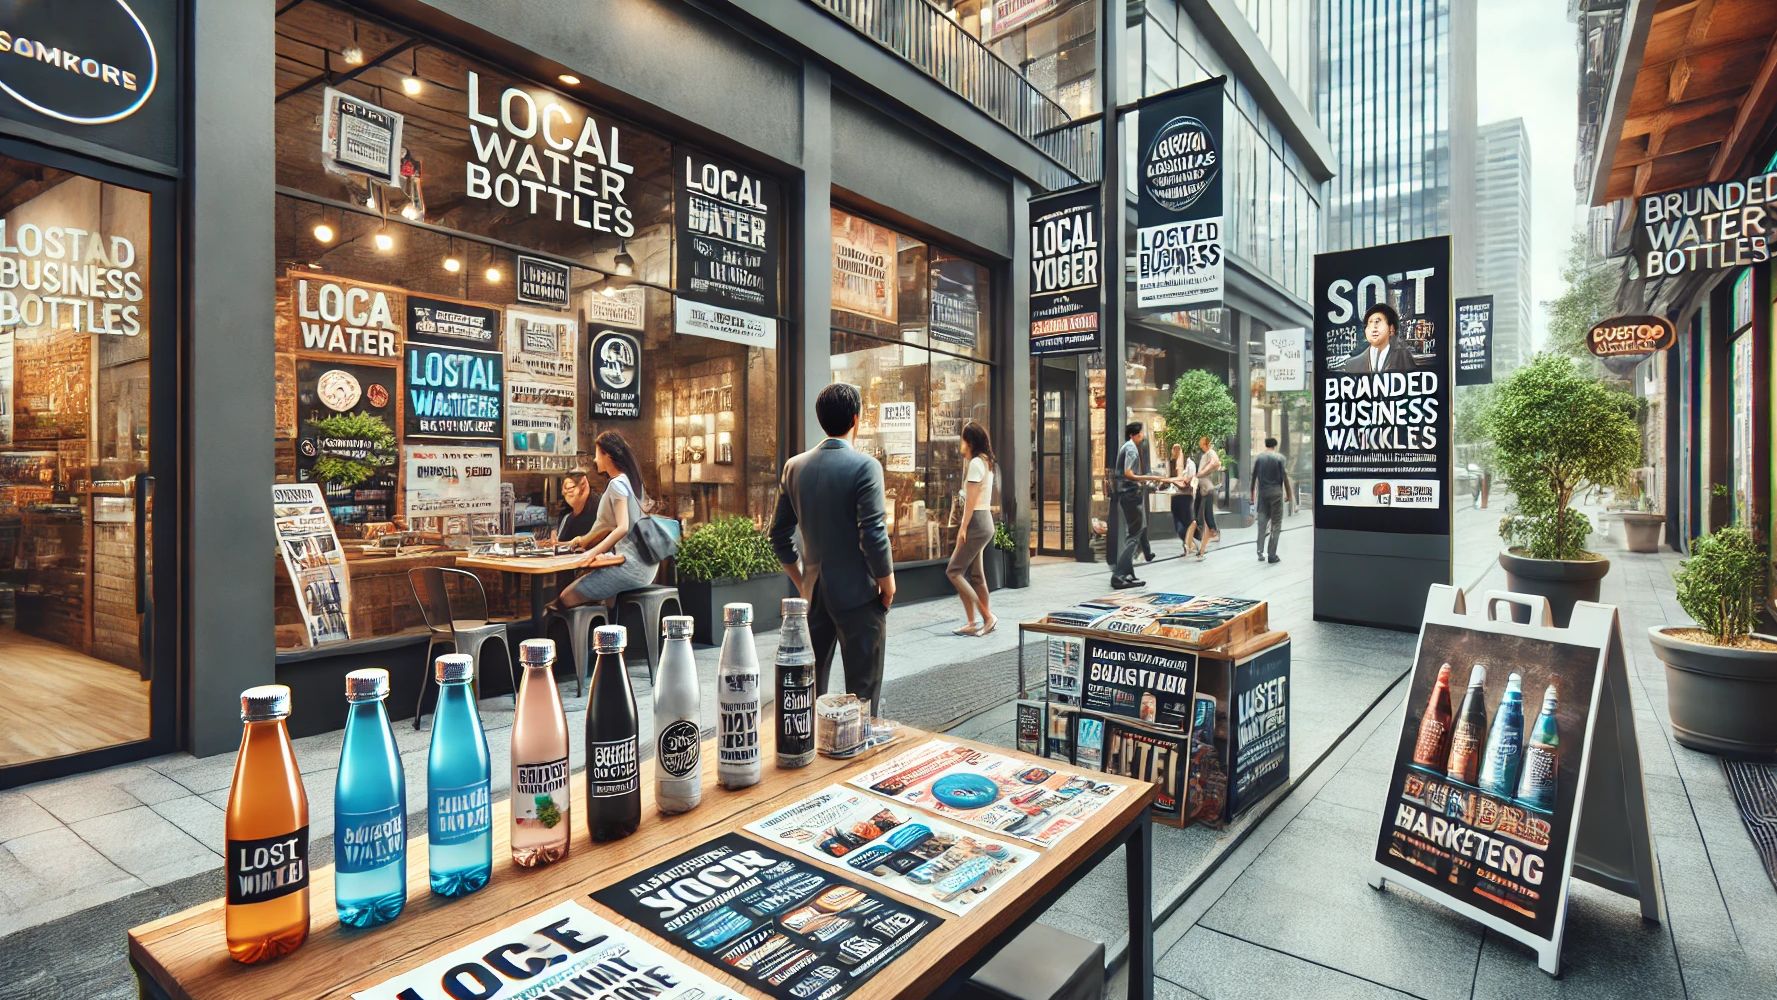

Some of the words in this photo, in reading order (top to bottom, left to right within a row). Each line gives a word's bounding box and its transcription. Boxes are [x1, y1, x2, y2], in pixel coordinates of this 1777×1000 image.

[468, 70, 635, 175] LOCAL
[469, 123, 628, 206] WATER
[686, 155, 768, 211] LOCAL
[466, 161, 635, 238] BOTTLES
[1032, 211, 1097, 259] LOCAL
[1645, 206, 1767, 251] WATER
[0, 257, 143, 302] BUSINESS
[0, 290, 141, 337] BOTTLES
[300, 321, 396, 357] WATER
[1325, 371, 1438, 400] BRANDED
[1325, 398, 1439, 427] BUSINESS
[240, 838, 300, 872] LOST
